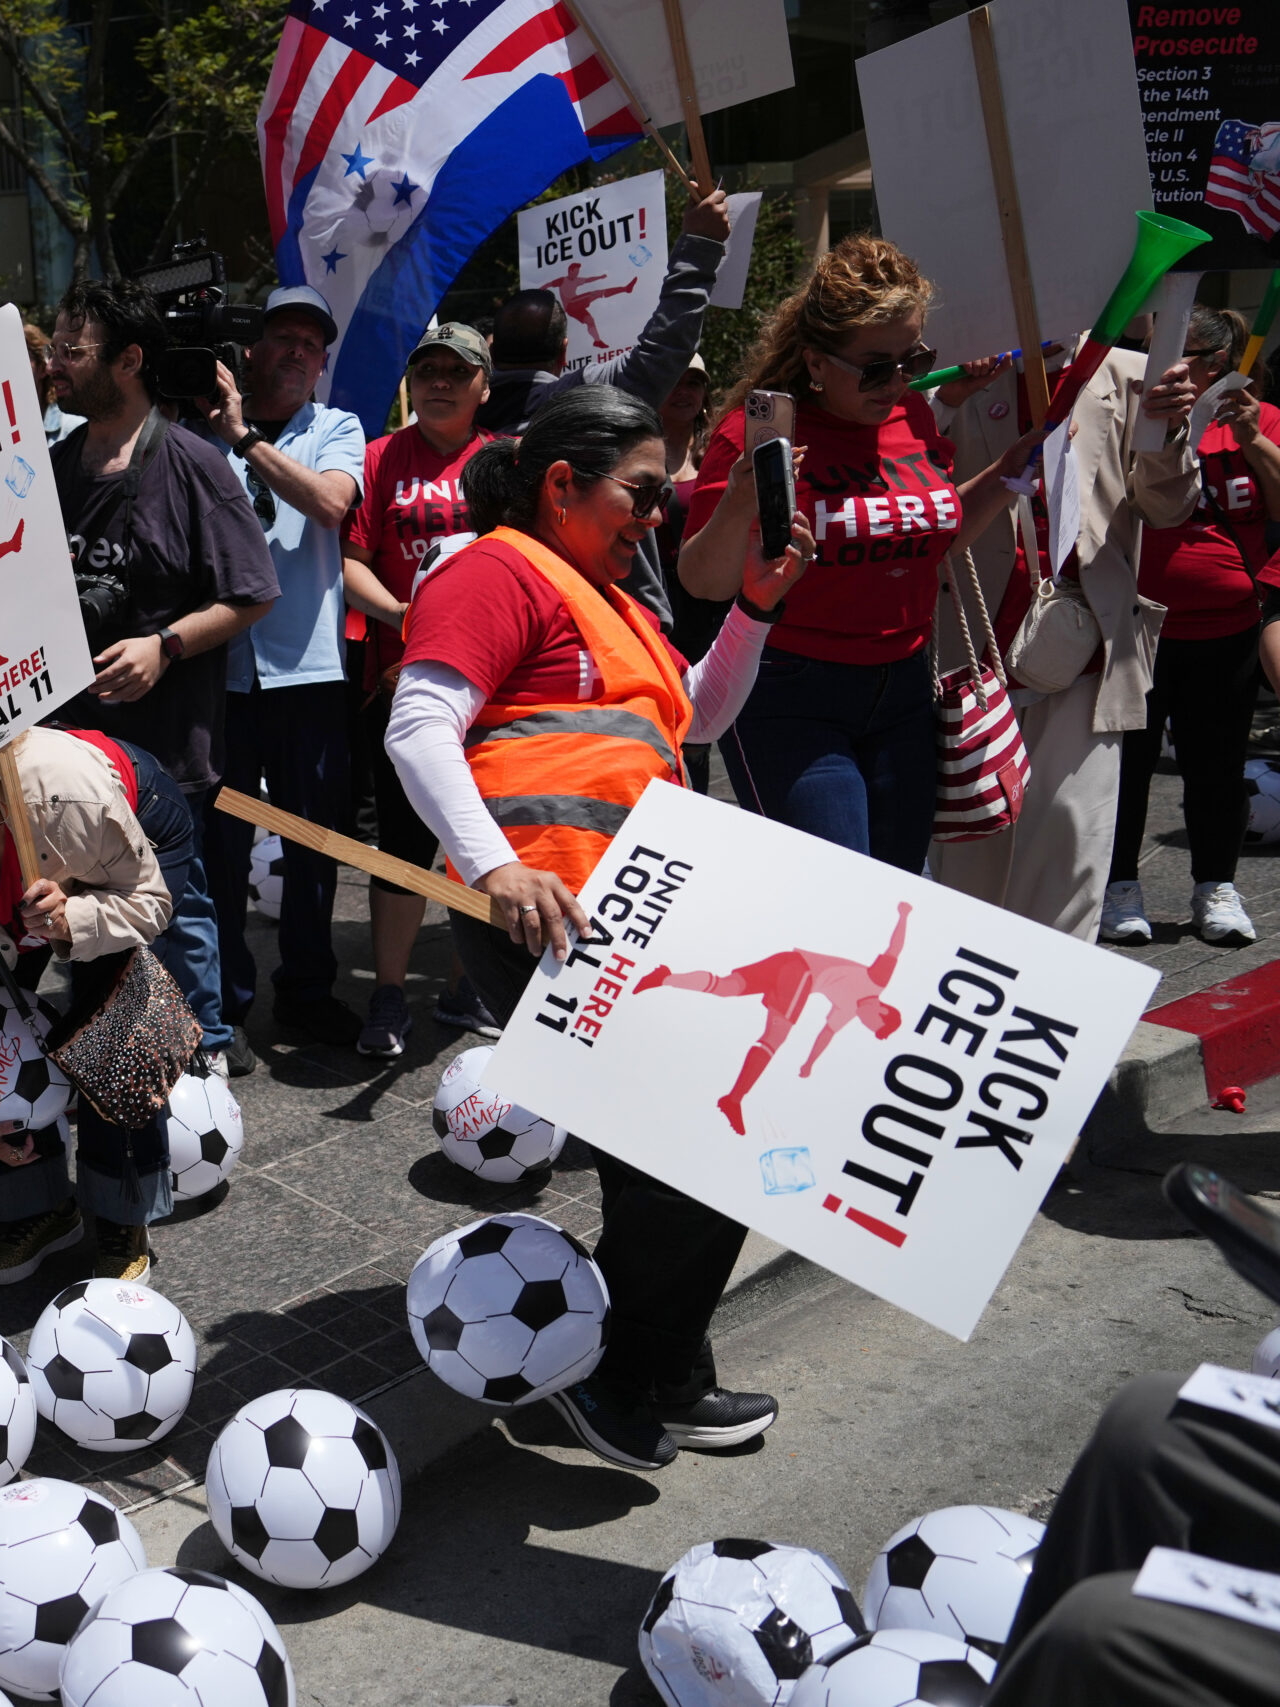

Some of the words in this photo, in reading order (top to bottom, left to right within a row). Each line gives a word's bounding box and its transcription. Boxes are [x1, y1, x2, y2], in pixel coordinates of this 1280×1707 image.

[1137, 5, 1241, 27] Remove
[1133, 32, 1258, 56] Prosecute
[1136, 66, 1197, 82] Section
[1201, 67, 1212, 80] 3
[1143, 88, 1170, 102] the
[1175, 87, 1209, 101] 14th
[1186, 149, 1198, 161] 4
[1160, 169, 1190, 182] U.S.
[537, 236, 573, 268] ICE
[578, 207, 646, 257] OUT!
[546, 198, 603, 239] KICK
[815, 489, 957, 540] HERE
[815, 534, 930, 567] LOCAL
[29, 669, 53, 703] 11
[565, 845, 666, 968] LOCAL
[622, 860, 694, 949] UNITE
[535, 993, 578, 1033] 11
[570, 952, 635, 1048] HERE!
[914, 946, 1019, 1057] ICE
[954, 1005, 1079, 1172] KICK
[447, 1095, 484, 1129] FAIR
[454, 1098, 511, 1141] GAMES
[822, 1053, 964, 1248] OUT!
